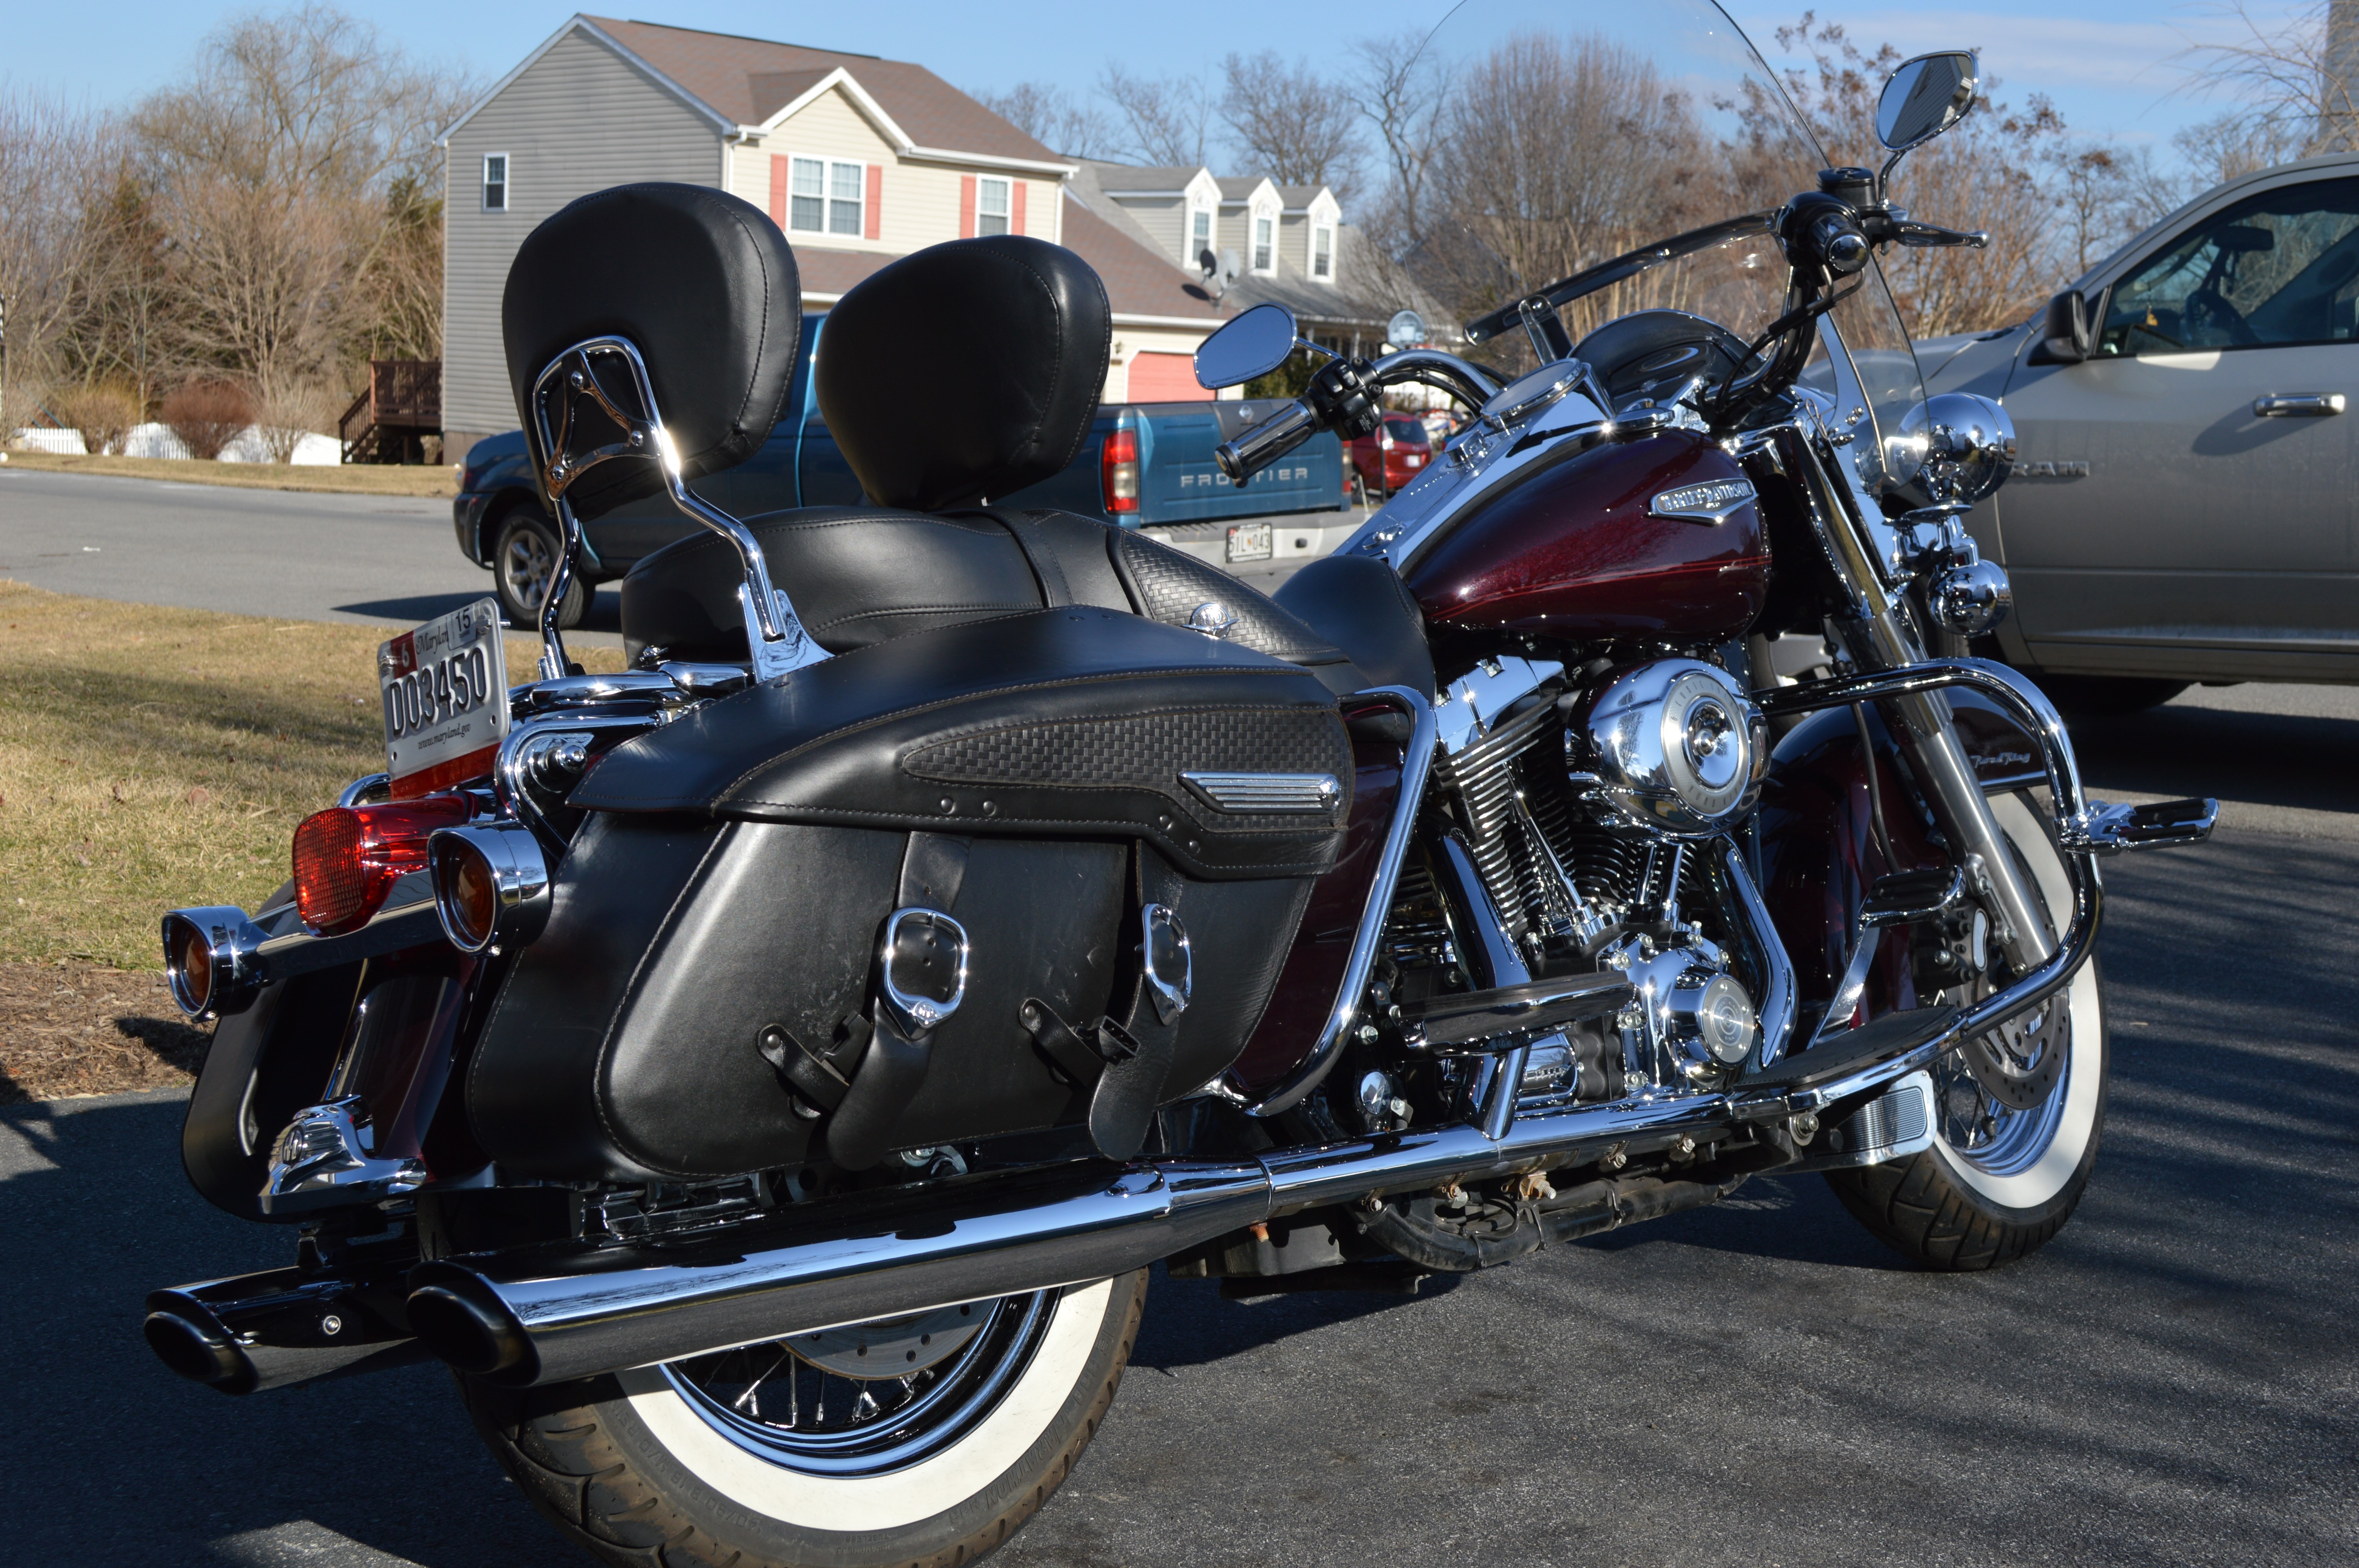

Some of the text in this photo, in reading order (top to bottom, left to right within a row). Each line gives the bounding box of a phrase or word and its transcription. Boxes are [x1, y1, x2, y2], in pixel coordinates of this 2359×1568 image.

[1181, 468, 1309, 488] FROTIER
[2009, 461, 2090, 477] RAM
[456, 608, 471, 632] 15
[416, 625, 449, 655] Marylan
[401, 642, 410, 668] 6
[389, 647, 487, 736] D03450
[418, 722, 471, 750] www.maryland.gov
[985, 1410, 1071, 1509] MARATHON
